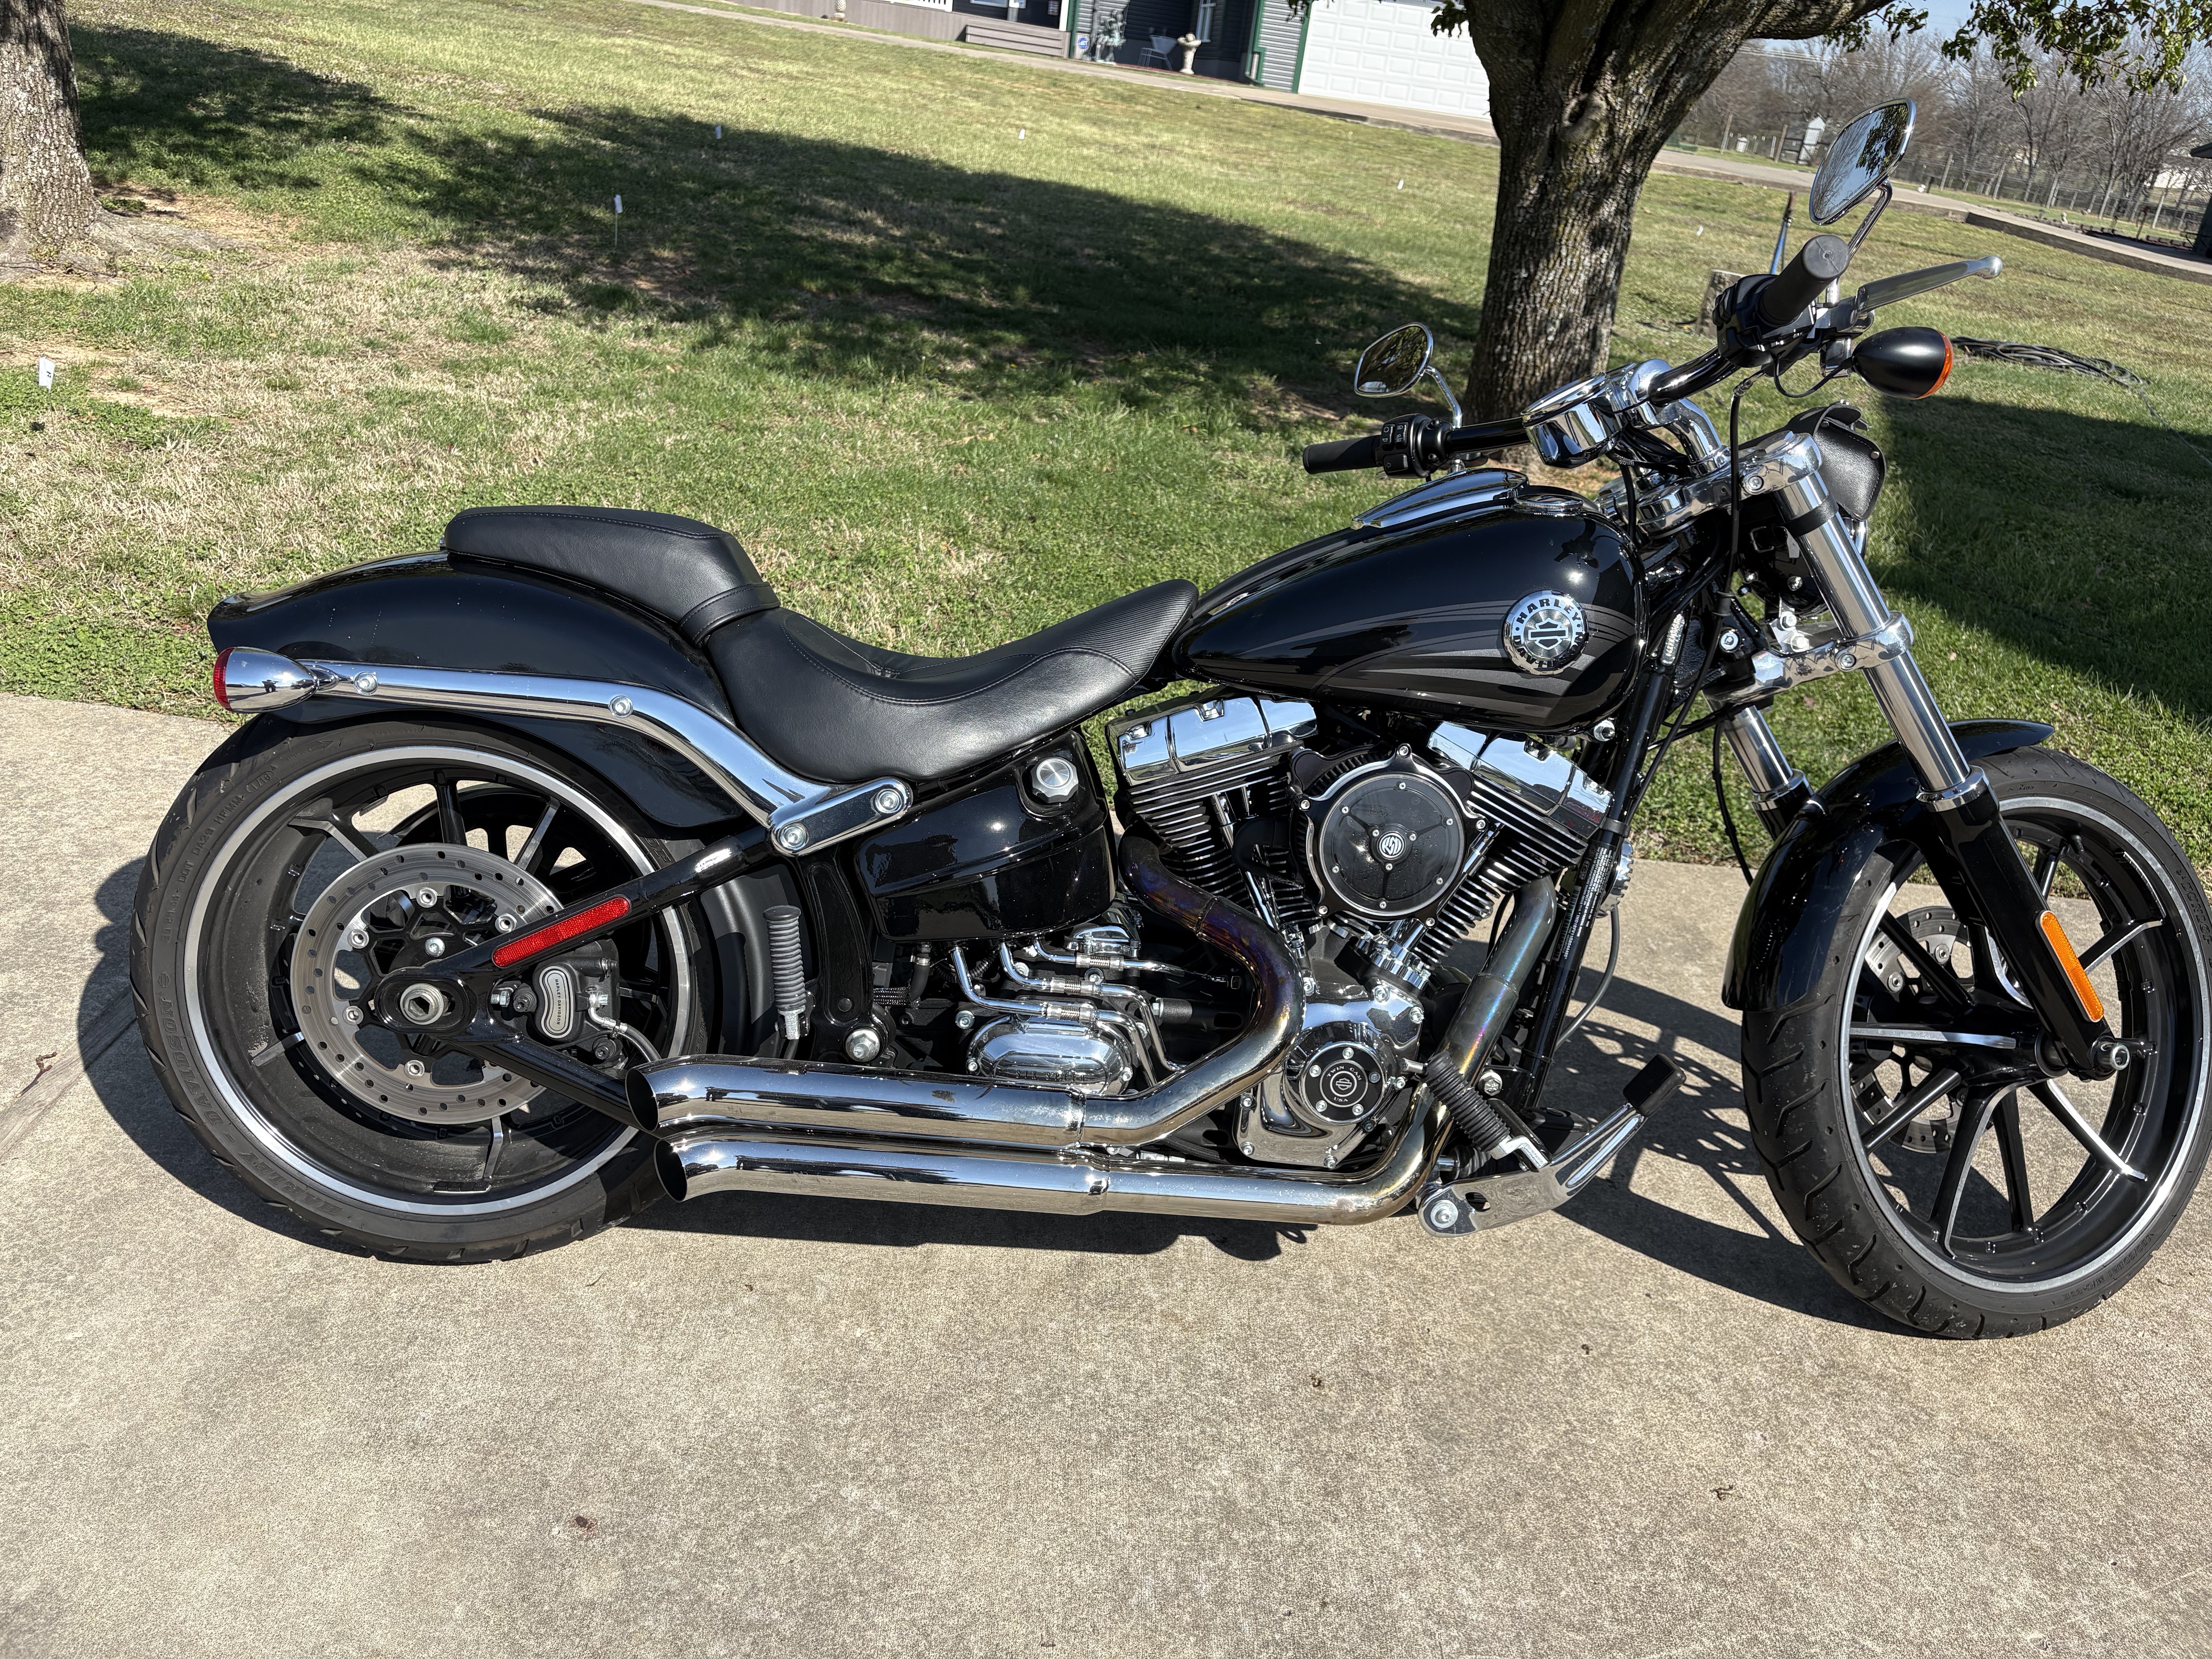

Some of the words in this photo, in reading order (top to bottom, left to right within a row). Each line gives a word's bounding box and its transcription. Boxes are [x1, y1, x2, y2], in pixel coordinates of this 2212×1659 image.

[1516, 598, 1582, 625] HARLEY
[1512, 632, 1585, 668] DAVIDSON
[2182, 881, 2212, 946] DUNLOP
[1015, 1069, 1037, 1080] SIX
[1045, 1072, 1085, 1082] SPEED
[1326, 1065, 1345, 1080] TWIN
[1350, 1067, 1362, 1081] CAM
